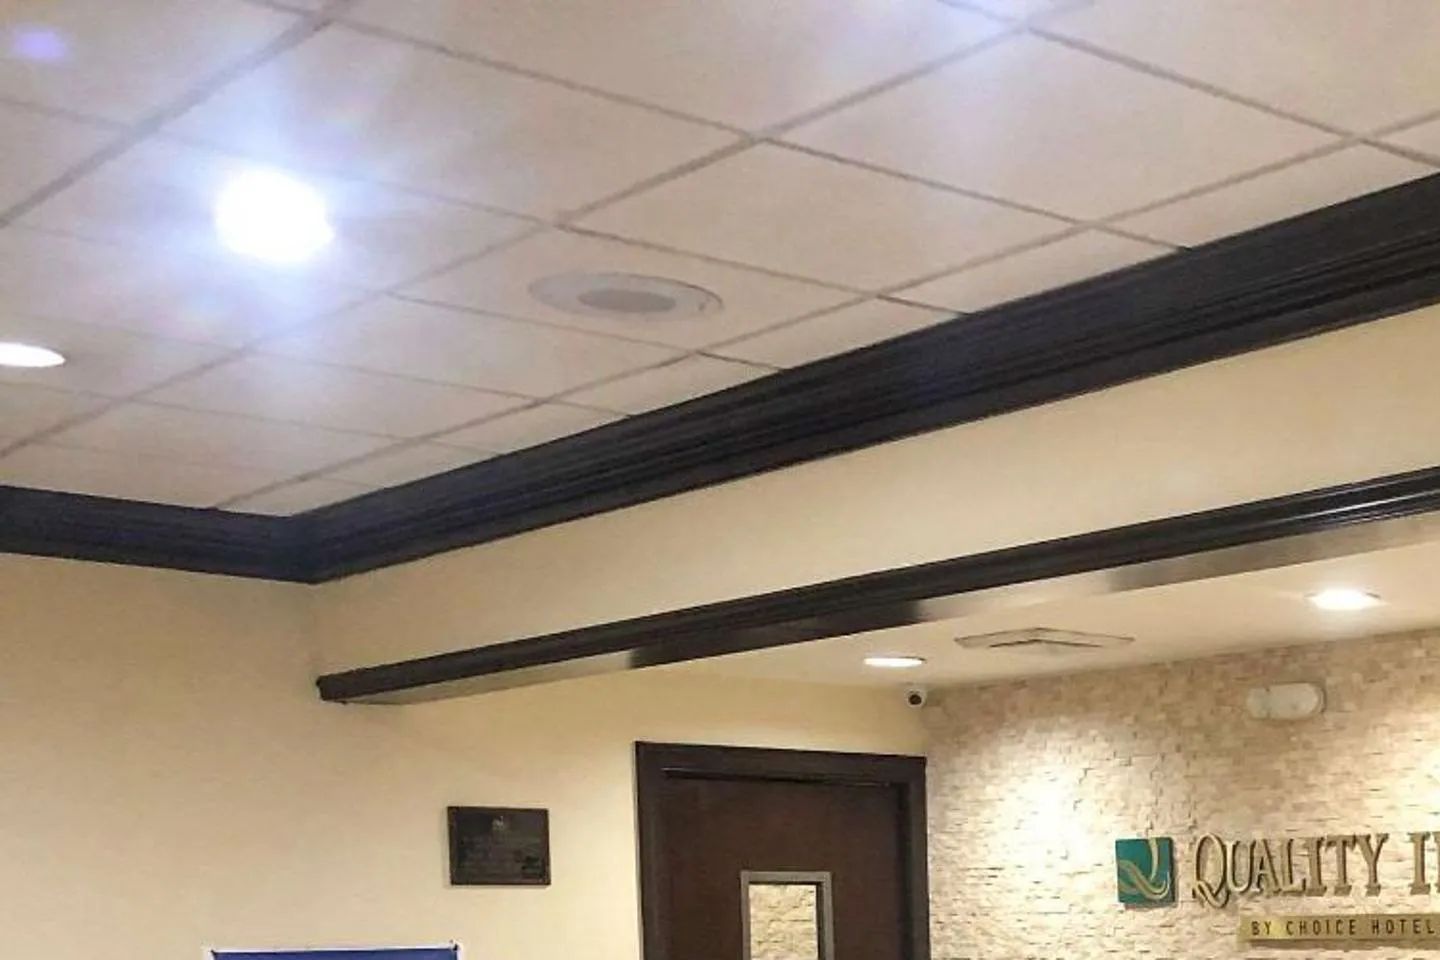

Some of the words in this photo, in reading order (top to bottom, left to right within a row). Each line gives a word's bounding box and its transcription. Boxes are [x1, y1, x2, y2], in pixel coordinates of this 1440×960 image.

[1192, 832, 1389, 908] QUALITY
[1251, 920, 1272, 936] BY
[1286, 919, 1357, 936] CHOICE
